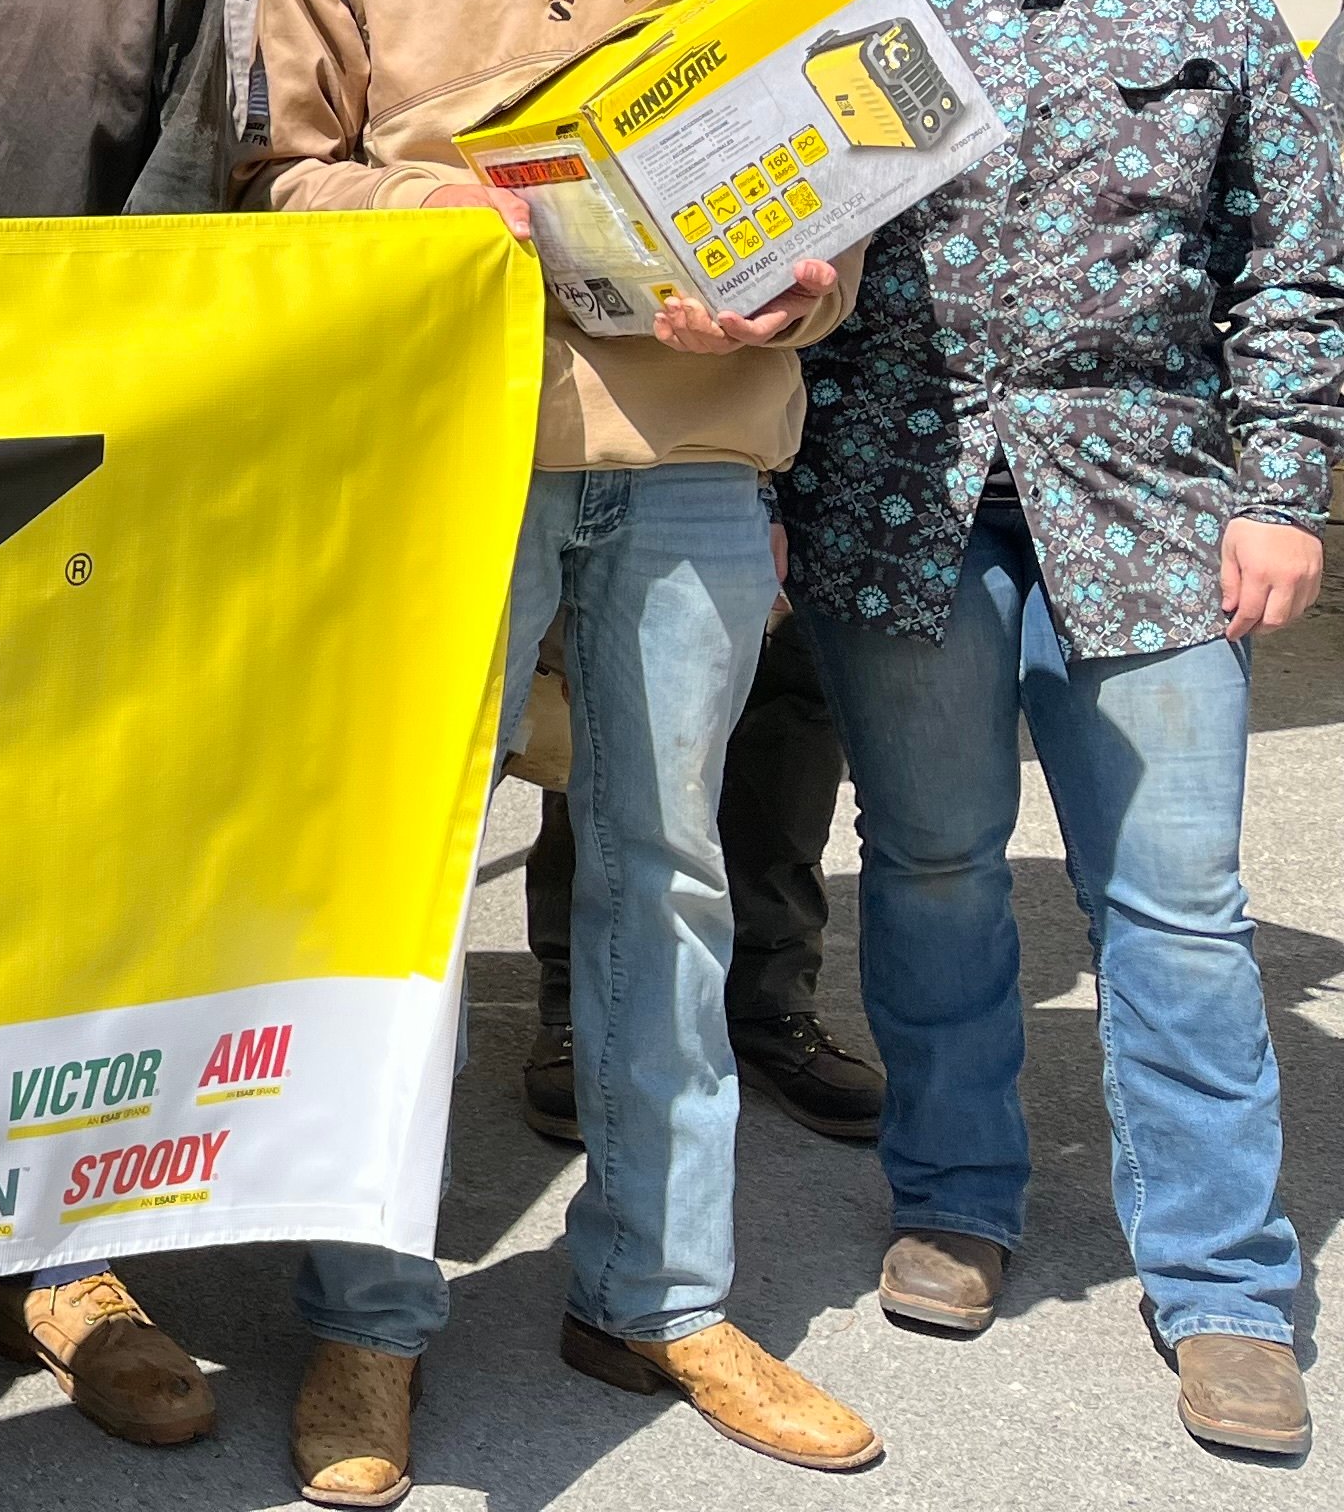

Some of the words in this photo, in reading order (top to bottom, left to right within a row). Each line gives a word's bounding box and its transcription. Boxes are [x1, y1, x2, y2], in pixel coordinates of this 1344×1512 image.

[613, 40, 728, 138] HANDYARC
[767, 152, 790, 171] 160
[774, 165, 796, 182] AMPS
[764, 209, 779, 224] 12
[716, 251, 779, 296] HANDYARC
[795, 221, 826, 245] STICK
[825, 193, 867, 225] WELDER
[730, 231, 744, 245] 50
[746, 235, 761, 248] 60
[198, 1024, 293, 1089] AMI
[9, 1049, 162, 1121] VICTOR
[63, 1129, 231, 1205] STOODY
[140, 1199, 153, 1207] AN
[154, 1195, 177, 1206] ESAB
[180, 1191, 208, 1202] BRAND
